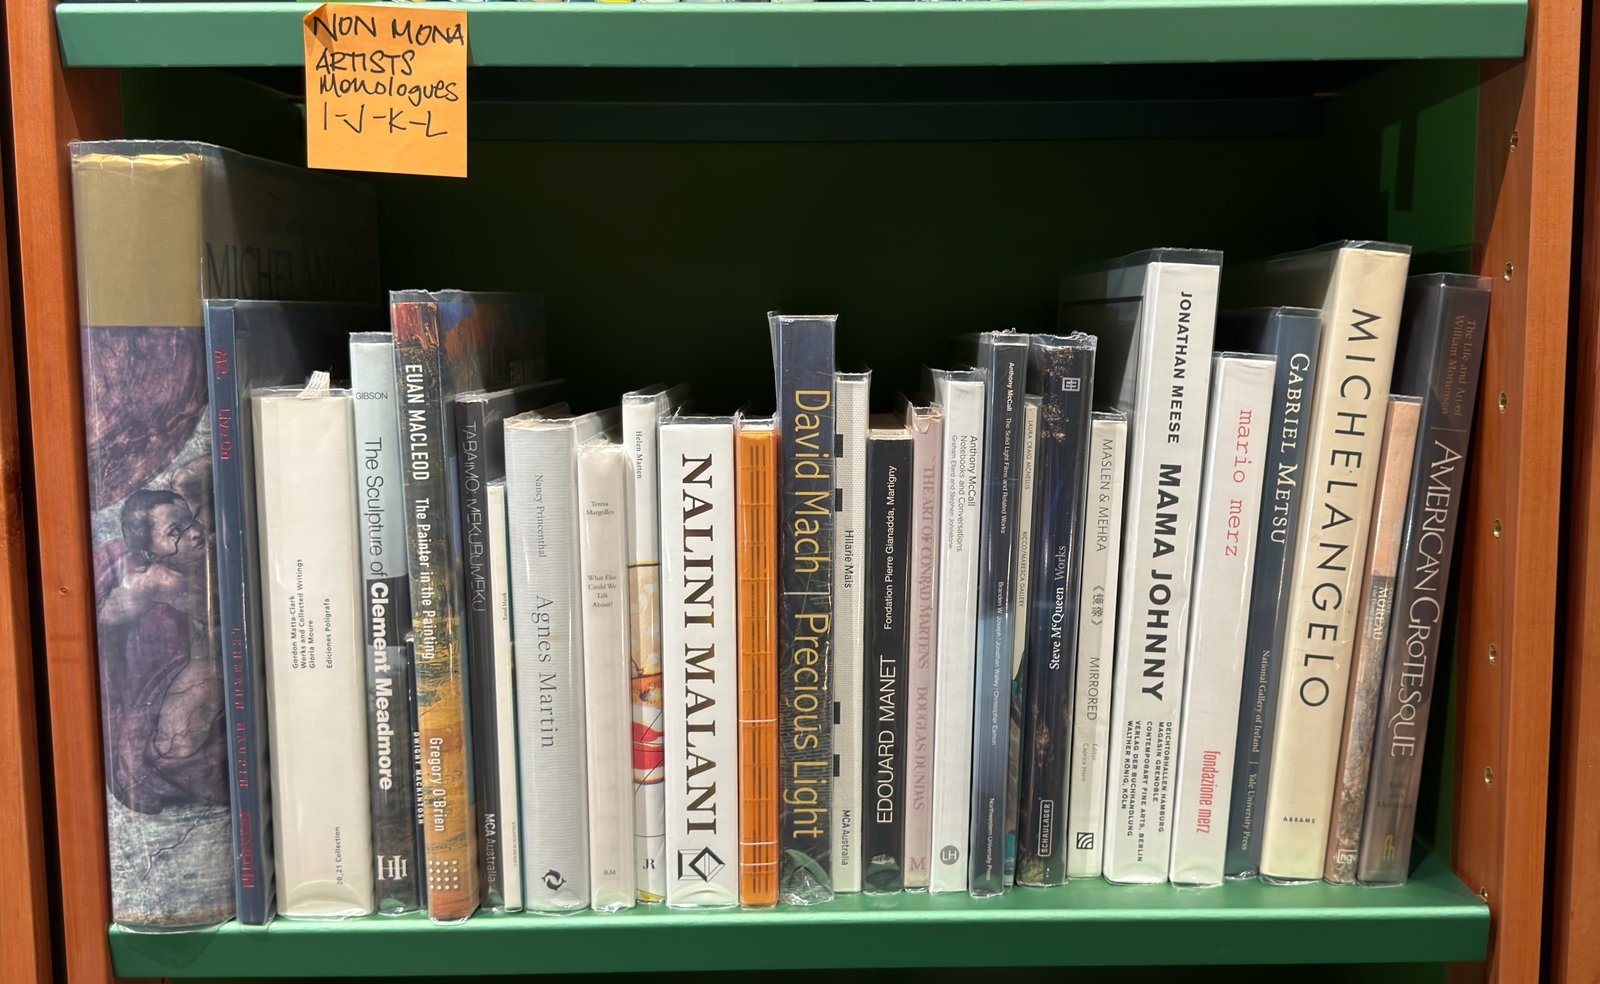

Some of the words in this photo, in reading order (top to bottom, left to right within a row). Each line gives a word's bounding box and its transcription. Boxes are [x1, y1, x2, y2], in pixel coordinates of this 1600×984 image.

[313, 13, 377, 42] NON
[391, 18, 465, 46] MONA
[315, 48, 416, 76] ARTISTS
[320, 73, 460, 107] Monologues
[1173, 291, 1193, 378] JONATHAN
[405, 364, 425, 403] EUAN
[1007, 362, 1015, 388] Anthony
[356, 391, 388, 401] GIBSON
[1006, 390, 1014, 411] McCall
[1168, 385, 1185, 443] MEESE
[1280, 353, 1310, 453] GABRIEL
[364, 437, 383, 470] The
[408, 409, 430, 480] MACLEOD
[795, 390, 830, 479] David
[1004, 430, 1012, 445] Solid
[1231, 409, 1254, 483] mario
[463, 421, 480, 495] TABAIMO:
[959, 435, 968, 478] Notebooks
[967, 435, 978, 473] Anthony
[1003, 447, 1011, 461] Light
[1003, 463, 1011, 478] Films
[1100, 438, 1113, 490] MASLEN
[533, 474, 546, 503] Nancy
[886, 465, 897, 505] Martigny
[922, 466, 936, 495] THE
[958, 480, 966, 495] and
[967, 476, 977, 507] McCall
[1099, 494, 1109, 503] &
[364, 475, 386, 556] Sculpture
[415, 498, 430, 520] The
[922, 497, 935, 523] ART
[948, 491, 956, 516] Stephen
[1001, 492, 1009, 514] Related
[1152, 464, 1182, 558] MAMA
[1271, 463, 1298, 544] METSU
[1299, 308, 1383, 708] MICHELANGELO
[1415, 440, 1463, 592] AMERICAN
[535, 505, 548, 558] Princenthal
[682, 453, 715, 628] NALINI
[795, 491, 830, 574] Mach
[885, 508, 896, 555] Gianadda,
[921, 525, 934, 543] OF
[957, 497, 966, 552] Conversations
[1000, 516, 1008, 534] Works
[1096, 507, 1109, 552] MEHRA
[1225, 500, 1244, 557] merz
[416, 524, 434, 567] Painter
[844, 530, 856, 562] Hilarie
[1055, 545, 1067, 581] Works
[370, 561, 388, 578] of
[419, 571, 434, 584] in
[844, 564, 855, 589] Mais
[885, 556, 894, 583] Pierre
[918, 546, 934, 601] CONRAD
[297, 593, 305, 627] Collected
[421, 587, 436, 606] the
[884, 584, 893, 630] Fondation
[1018, 583, 1026, 608] GALLERY
[1051, 587, 1065, 639] McQueen
[1373, 587, 1389, 640] MOREAU
[289, 595, 298, 639] Matta-Clark
[298, 629, 306, 643] and
[307, 620, 315, 644] Moure
[371, 580, 391, 673] Clement
[422, 610, 438, 660] Painting
[532, 595, 556, 663] Agnes
[1142, 569, 1173, 701] JOHNNY
[291, 641, 299, 669] Gordon
[325, 634, 333, 669] Ediciones
[917, 605, 932, 670] MARTENS
[1049, 642, 1062, 670] Steve
[299, 645, 307, 669] Works
[307, 646, 316, 669] Gloria
[1259, 649, 1271, 683] National
[795, 612, 830, 751] Precious
[879, 655, 896, 722] MANET
[1087, 657, 1100, 720] MIRRORED
[1388, 596, 1441, 757] GROTESQUE
[539, 672, 559, 750] Martin
[1254, 685, 1268, 712] Gallery
[375, 679, 395, 791] Meadmore
[915, 686, 929, 752] DOUGLAS
[1125, 720, 1134, 756] WALTHER
[1133, 720, 1142, 751] VERLAG
[1254, 714, 1263, 724] of
[414, 731, 423, 766] DWIGHT
[684, 643, 717, 837] MALANI
[1142, 721, 1153, 785] CONTEMPORARY
[1156, 721, 1165, 757] MAGASIN
[1161, 721, 1172, 791] DEICHTORHALLEN
[1252, 725, 1263, 753] Ireland
[427, 737, 445, 786] Gregory
[877, 730, 894, 824] EDOUARD
[1131, 753, 1140, 770] DER
[1199, 751, 1222, 806] fondazione
[415, 769, 425, 826] MACKINTOSH
[784, 760, 830, 839] Light
[913, 755, 927, 811] DUNDAS
[1140, 787, 1149, 806] FINE
[1153, 760, 1163, 802] GRENOBLE
[1247, 773, 1257, 789] Yale
[432, 788, 448, 833] O'Brien
[841, 810, 851, 828] MCA
[1127, 772, 1138, 837] BUCHHANDLUNG
[1138, 808, 1147, 831] ARTS,
[1158, 793, 1168, 832] HAMBURG
[1196, 808, 1211, 833] merz
[1244, 790, 1255, 829] University
[334, 826, 342, 863] Collection
[484, 813, 497, 838] MCA
[1242, 830, 1252, 851] Press
[486, 838, 498, 883] Australia
[840, 829, 851, 866] Australia
[1136, 833, 1145, 862] BERLIN
